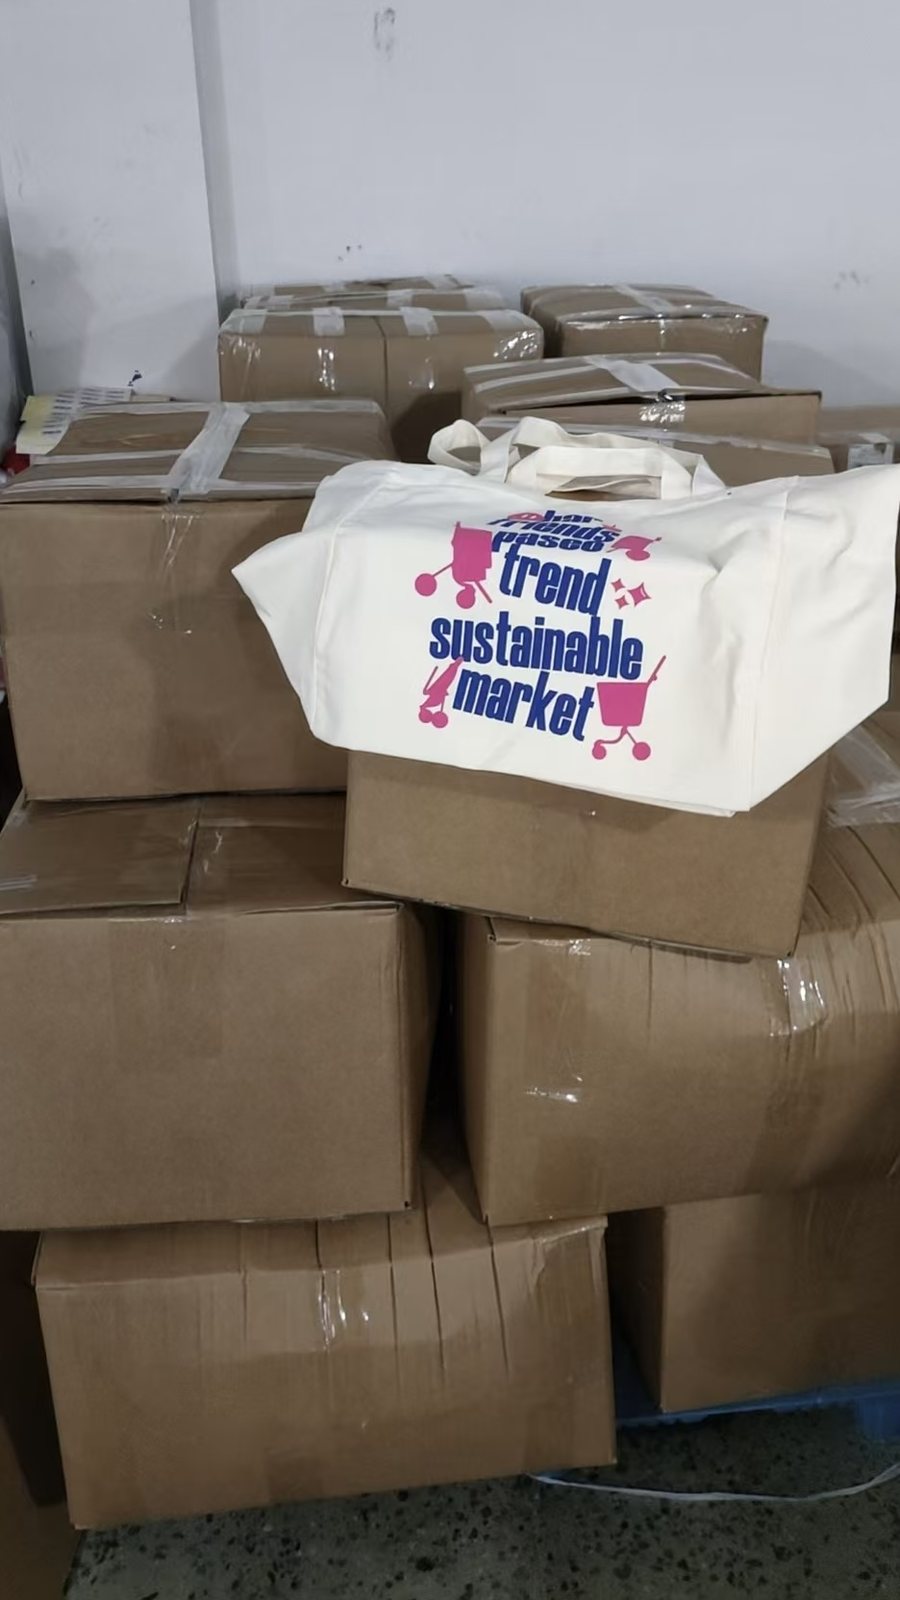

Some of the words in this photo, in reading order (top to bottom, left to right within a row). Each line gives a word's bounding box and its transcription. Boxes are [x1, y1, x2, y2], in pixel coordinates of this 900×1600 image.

[487, 517, 621, 543] friends
[499, 540, 611, 616] trend
[429, 611, 643, 680] sustainable
[453, 669, 595, 741] market
